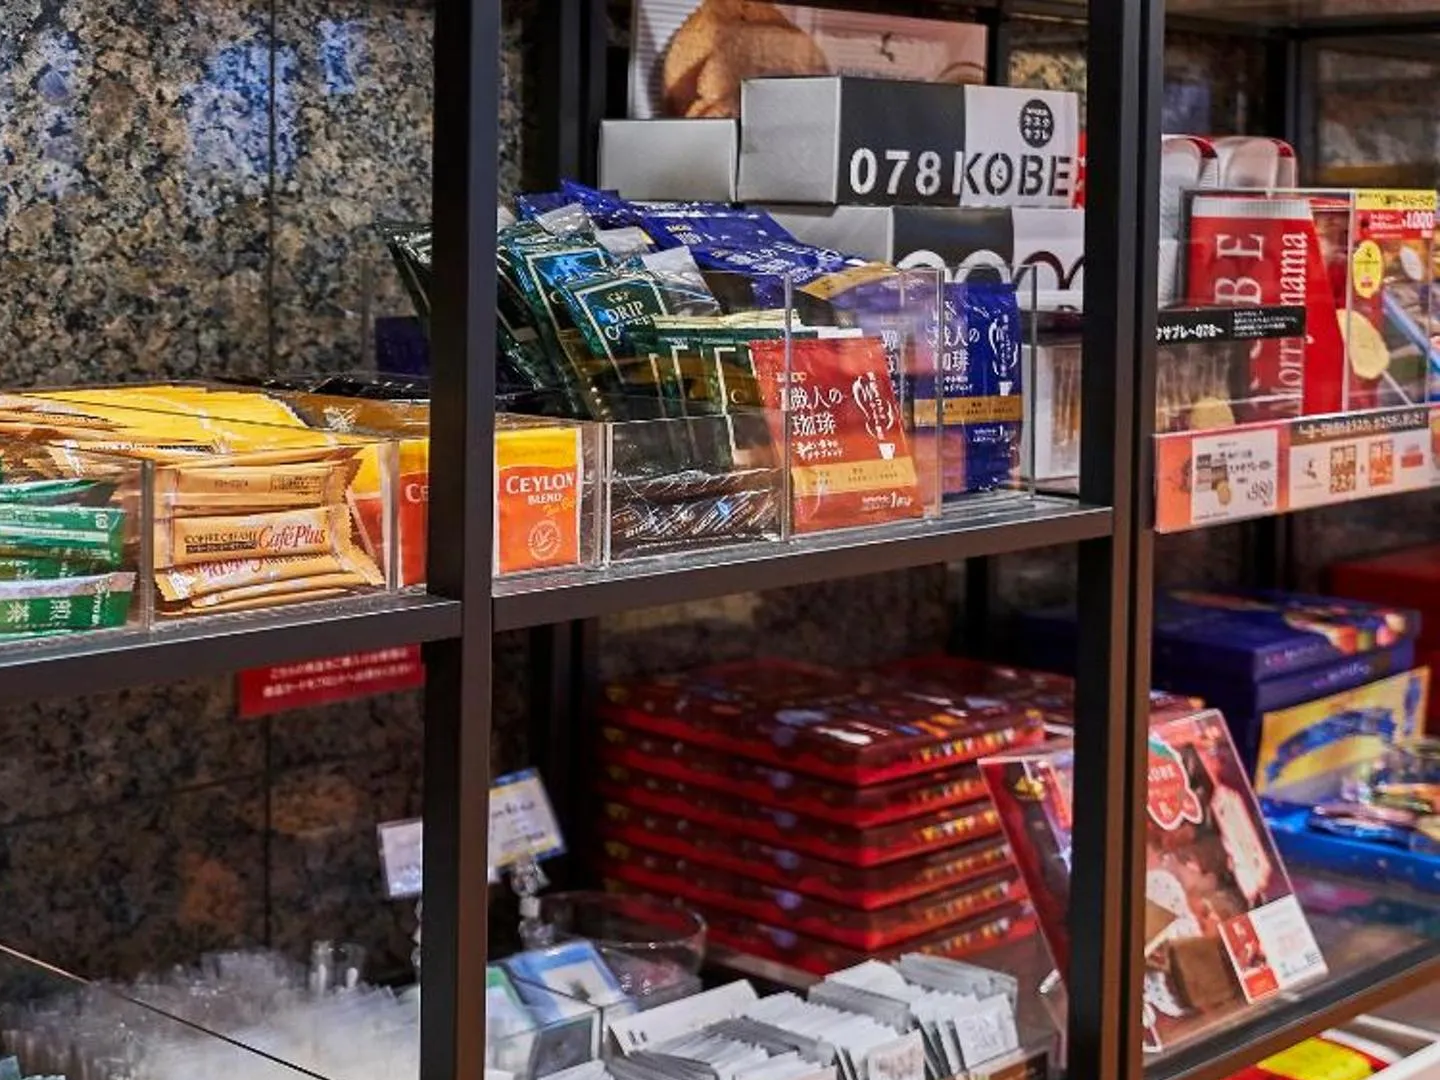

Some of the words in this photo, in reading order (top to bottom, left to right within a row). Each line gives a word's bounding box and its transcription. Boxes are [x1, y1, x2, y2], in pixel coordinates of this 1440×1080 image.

[849, 147, 942, 196] 078
[952, 151, 1070, 197] KOBE
[607, 301, 645, 324] DRIP
[506, 472, 575, 494] CEYLON
[527, 492, 563, 506] BLEND
